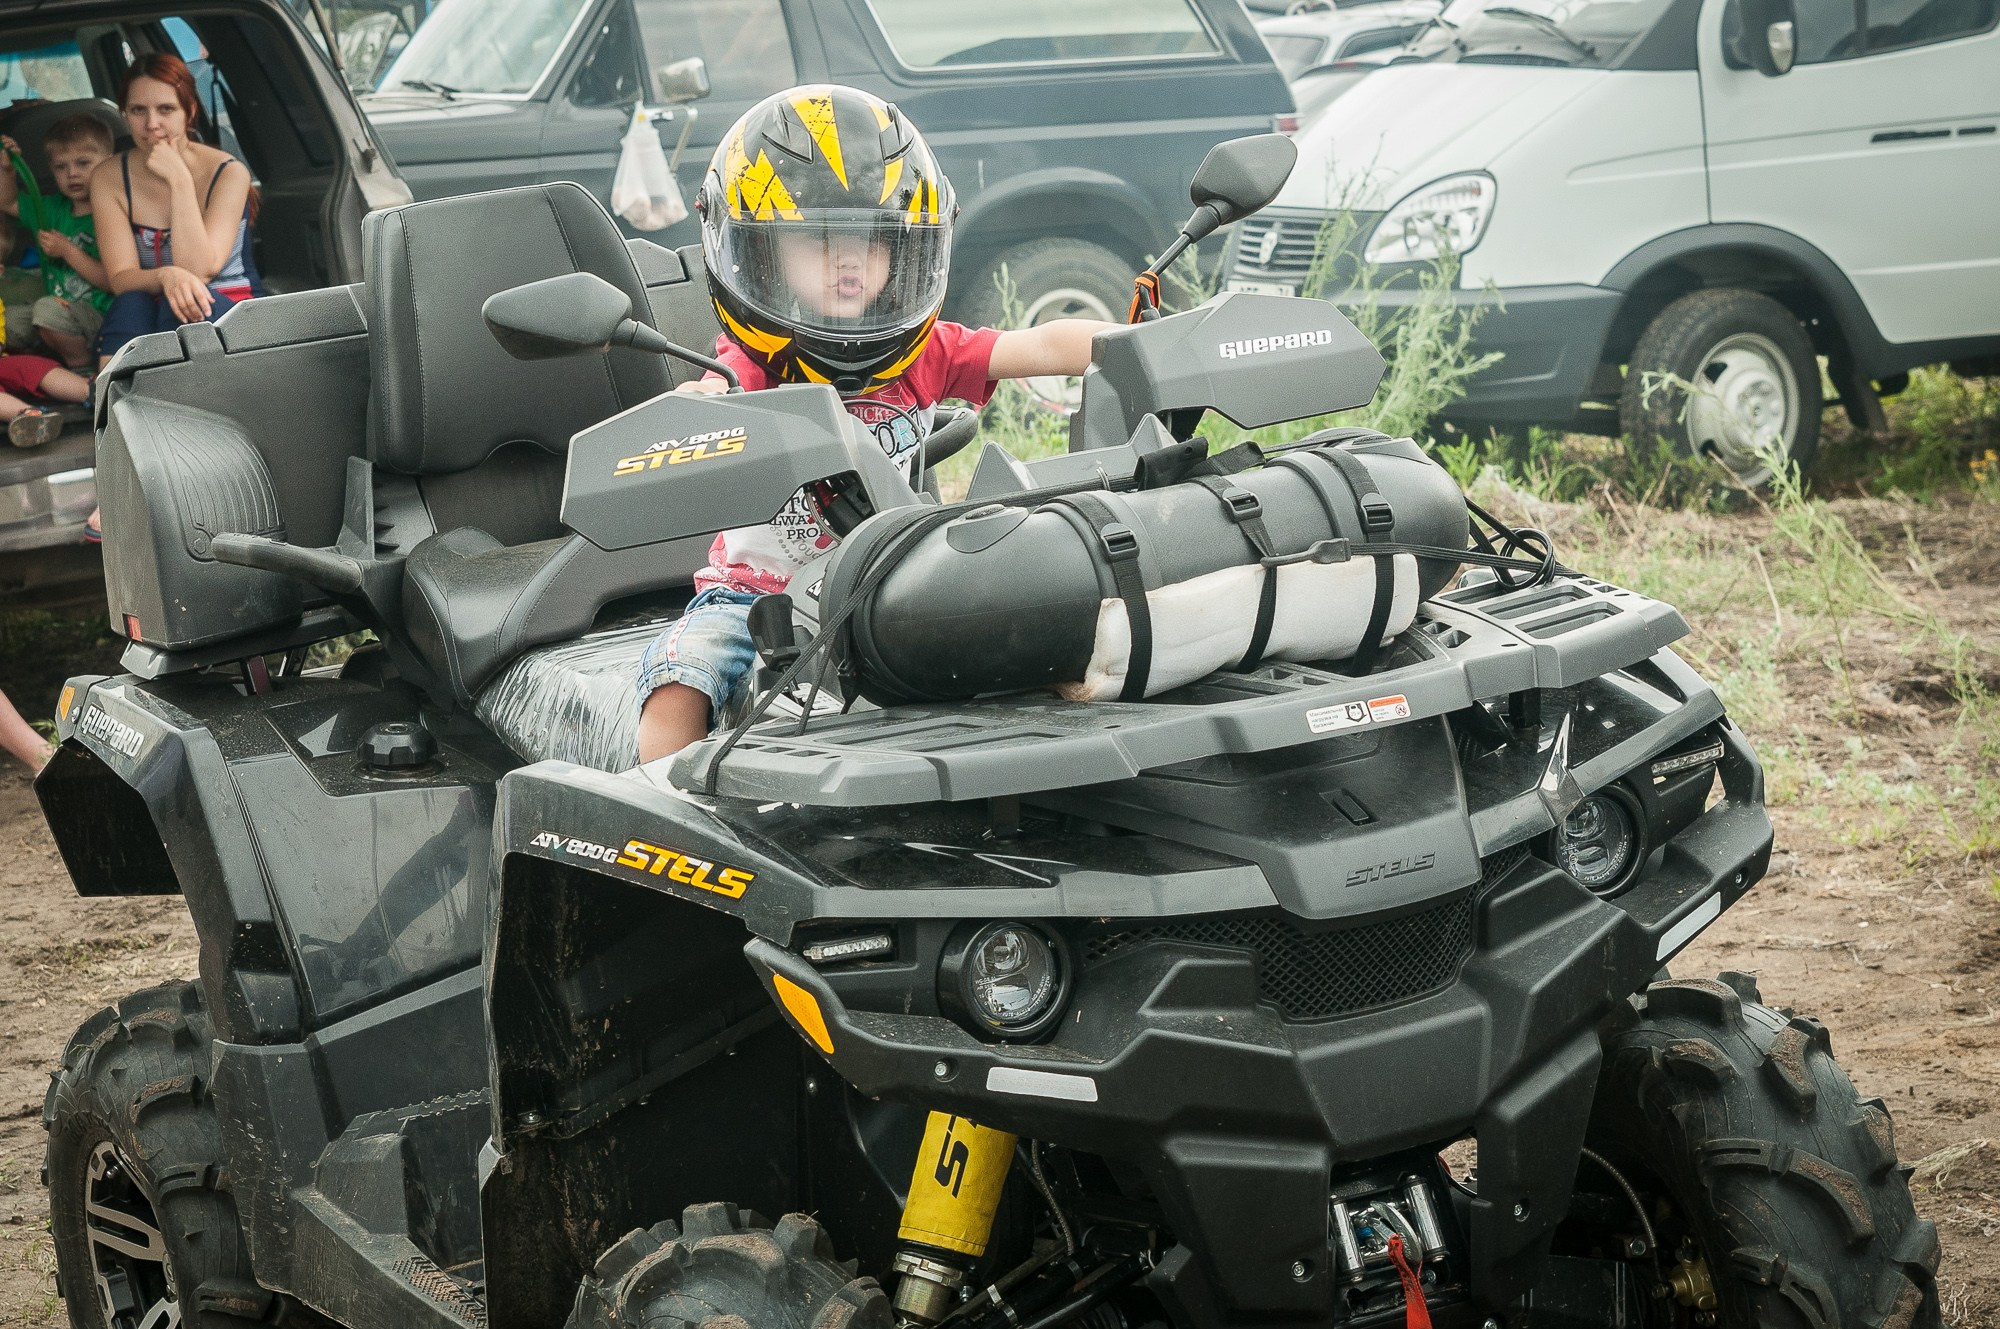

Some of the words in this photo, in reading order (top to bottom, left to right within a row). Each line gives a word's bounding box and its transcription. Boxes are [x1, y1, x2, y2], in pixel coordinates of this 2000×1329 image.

[613, 435, 747, 476] STELS
[643, 436, 688, 454] ATV
[530, 832, 569, 851] ATV
[616, 840, 755, 900] STELS
[1345, 851, 1436, 888] STELS
